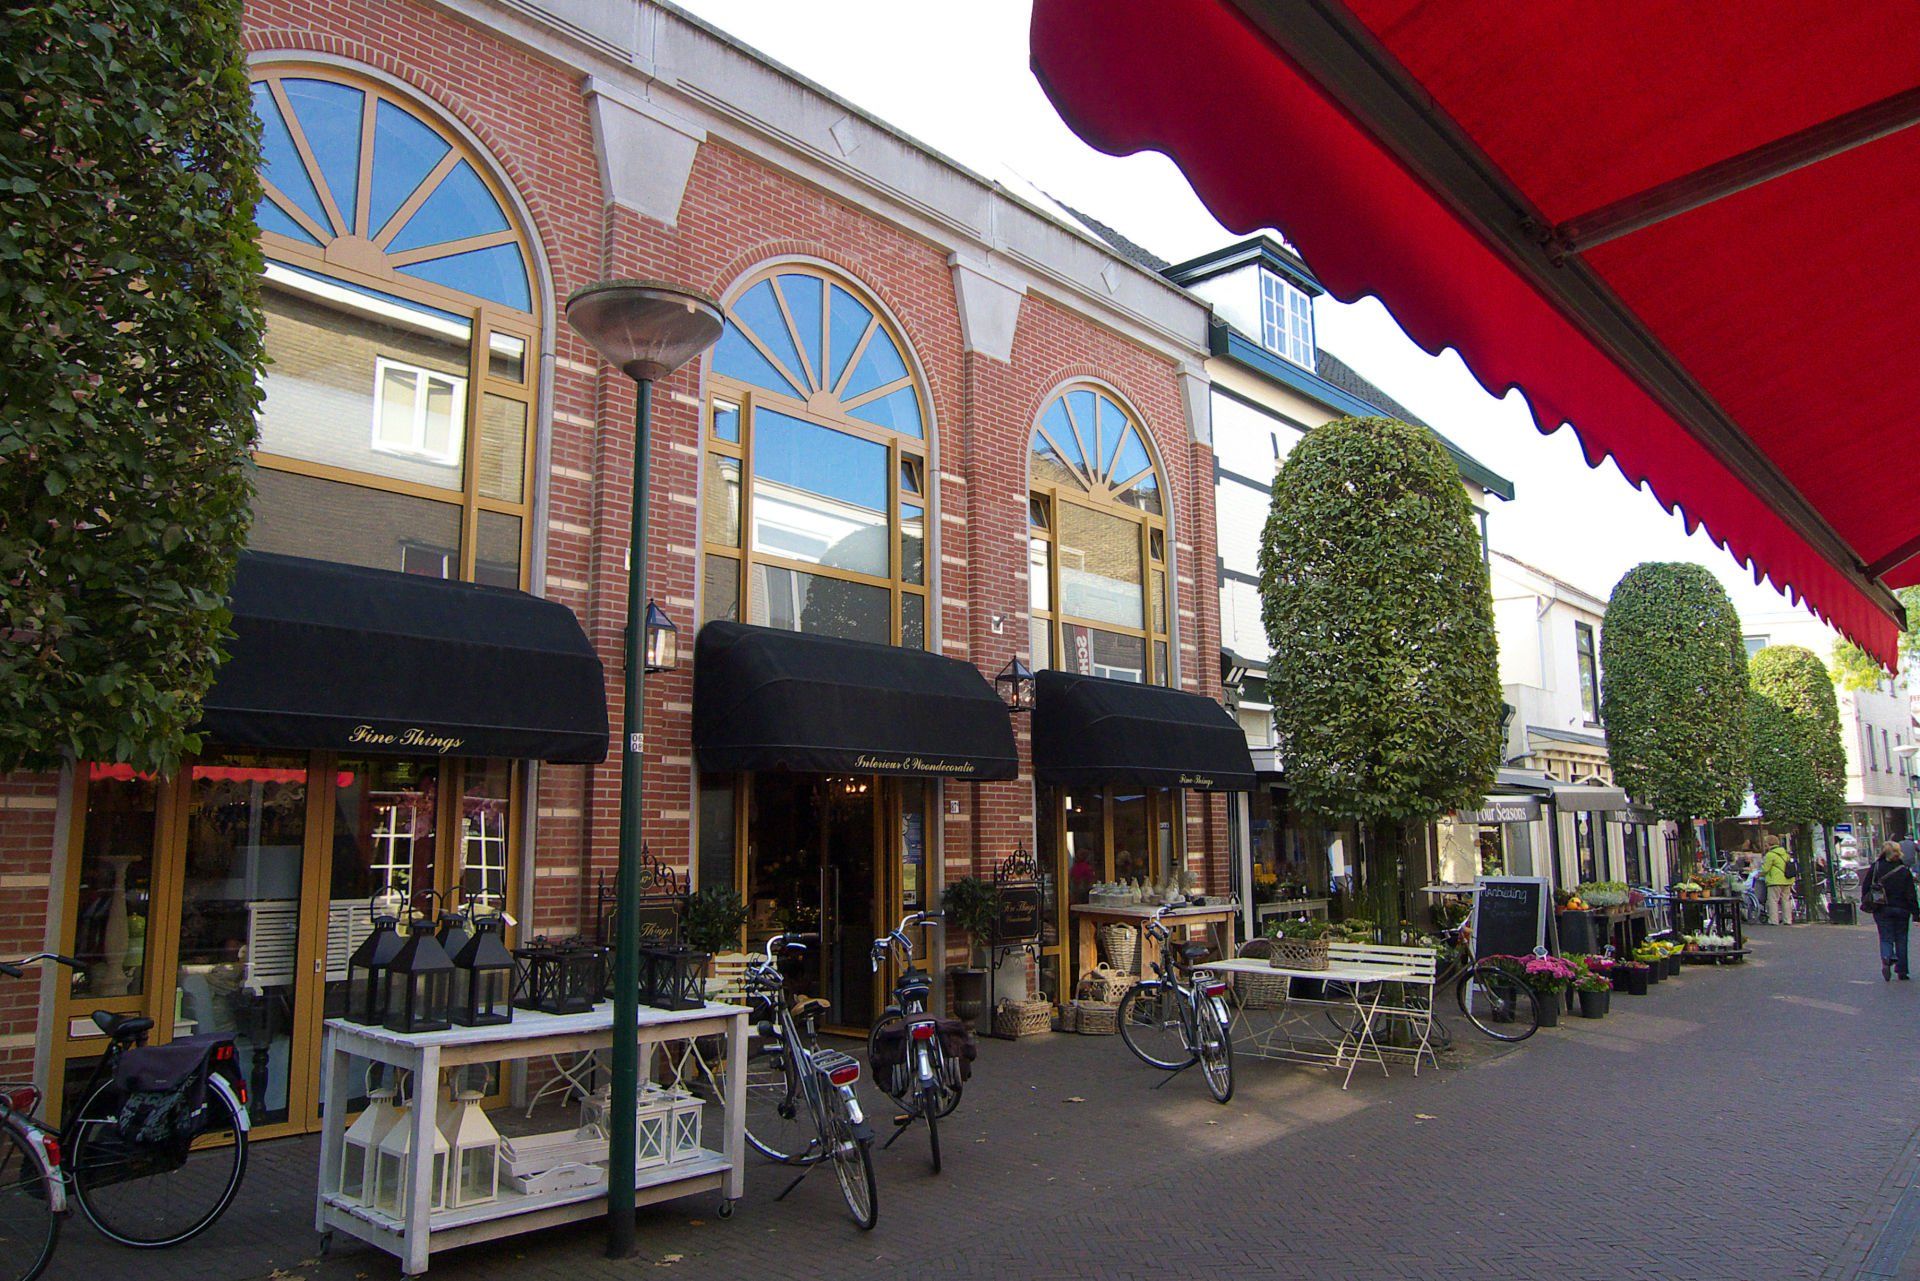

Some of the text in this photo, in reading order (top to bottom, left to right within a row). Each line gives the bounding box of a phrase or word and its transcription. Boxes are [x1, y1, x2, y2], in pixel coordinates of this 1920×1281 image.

[348, 724, 464, 754] Fine Things
[855, 754, 976, 773] Interieur & Woondecoratie
[1179, 773, 1214, 789] Fine Things
[1496, 802, 1527, 821] Seasons
[641, 922, 673, 938] Things
